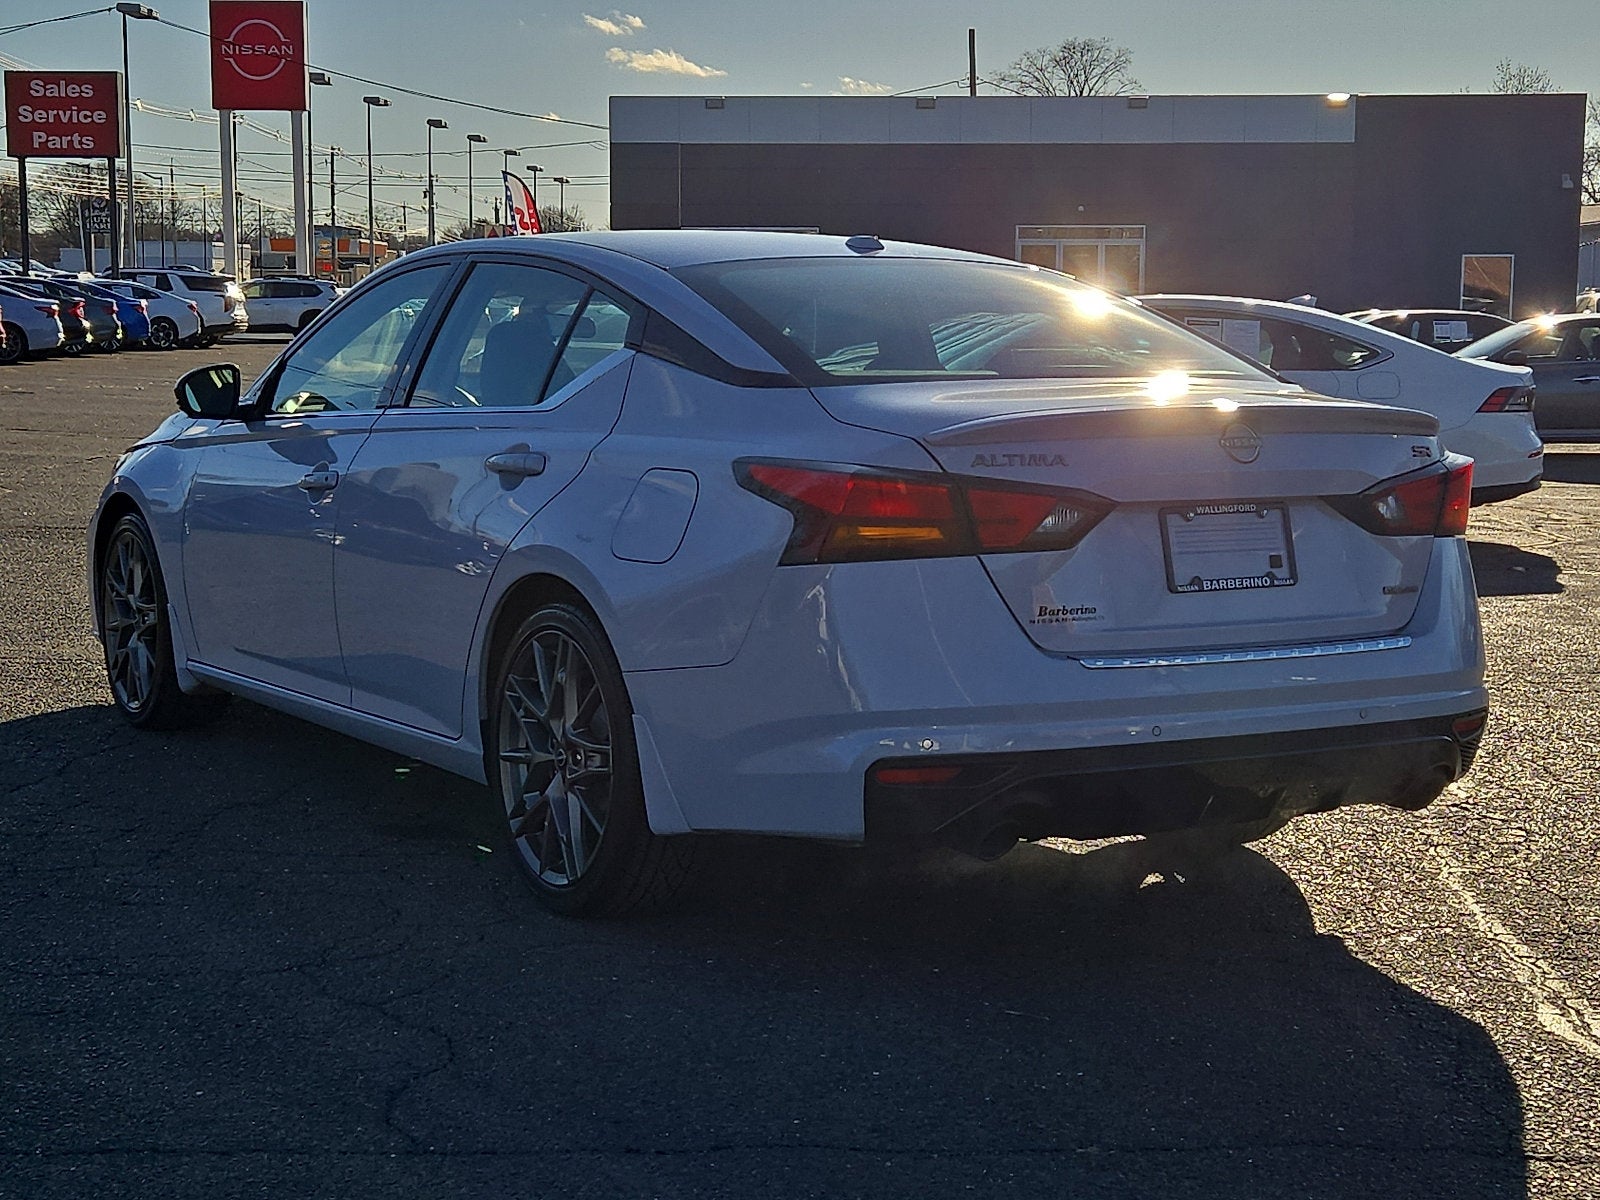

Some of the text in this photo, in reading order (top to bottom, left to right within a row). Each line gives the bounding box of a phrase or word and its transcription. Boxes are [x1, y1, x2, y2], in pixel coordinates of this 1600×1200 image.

[221, 44, 294, 55] NISSAN
[29, 79, 94, 98] Sales
[18, 105, 107, 123] Service
[32, 131, 95, 149] Parts
[970, 453, 1069, 468] ALTIMA
[1196, 504, 1257, 514] WALLINGFORD
[1202, 577, 1270, 591] BARBERINO
[1038, 604, 1097, 617] Barberino
